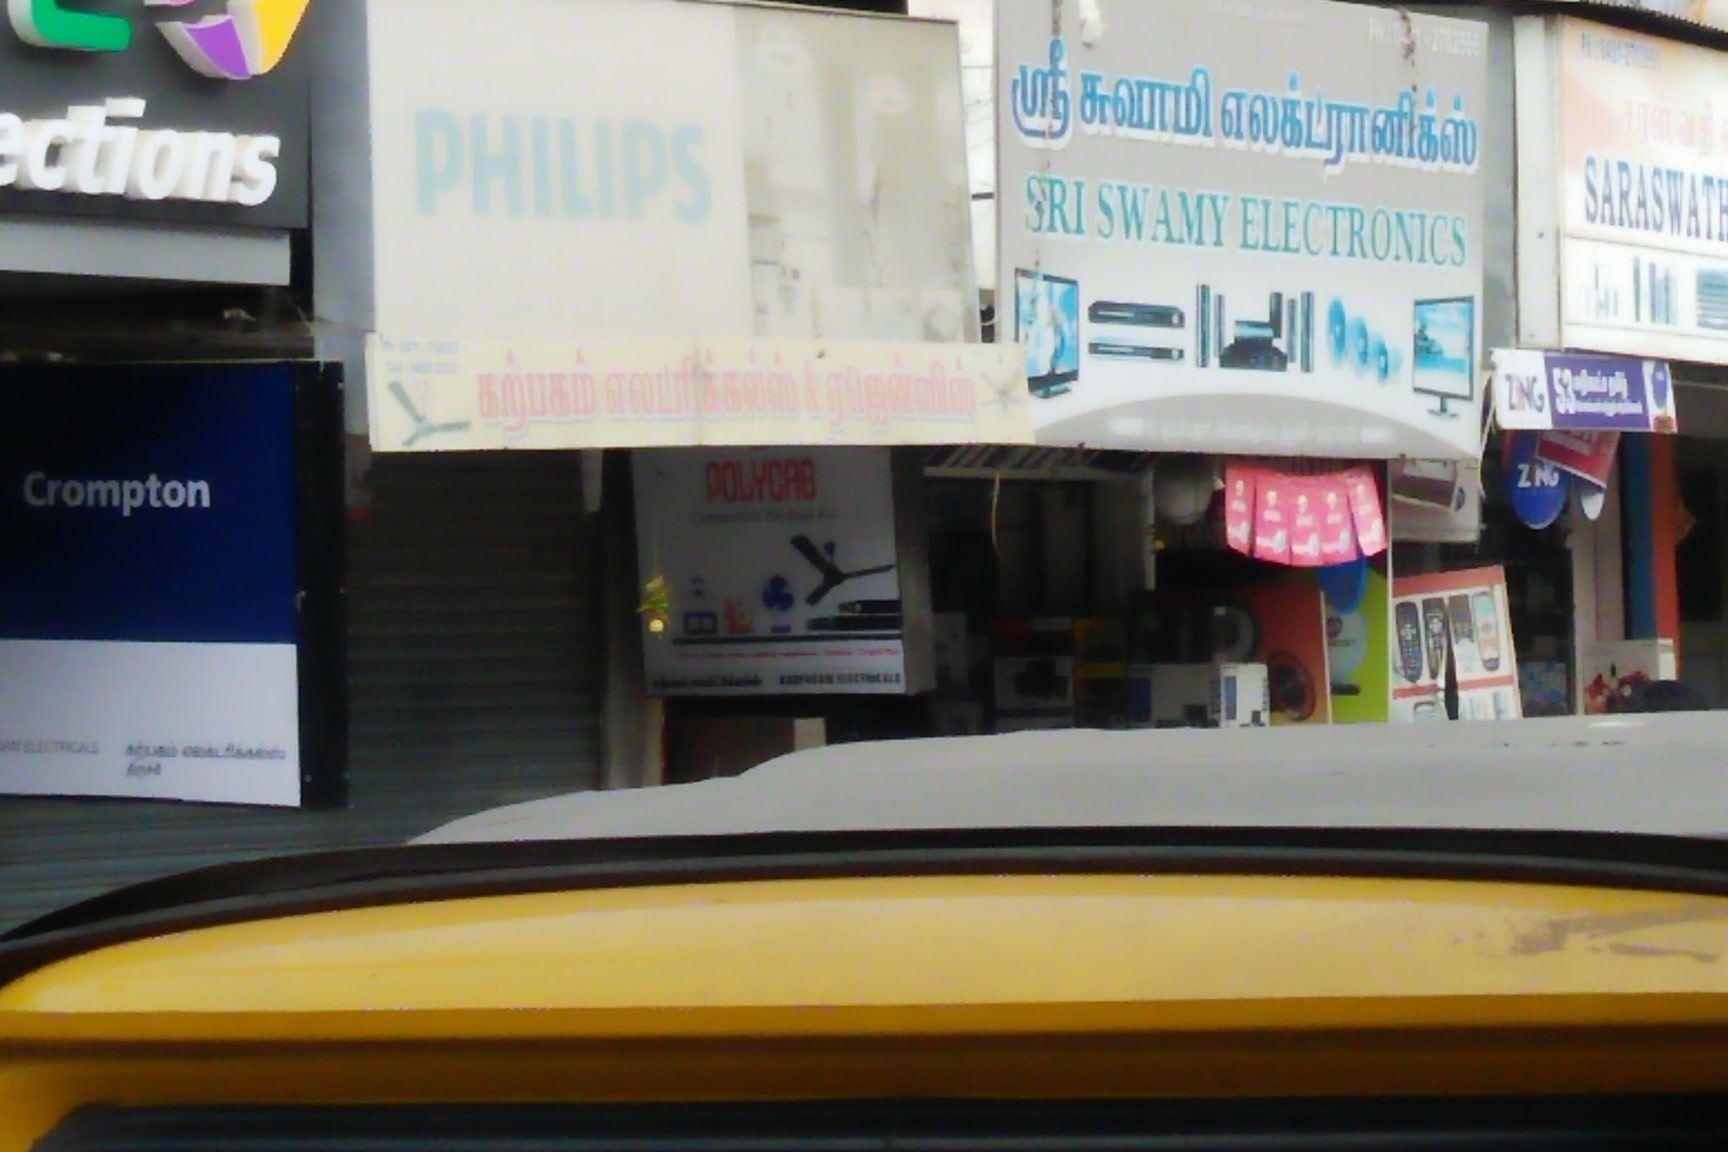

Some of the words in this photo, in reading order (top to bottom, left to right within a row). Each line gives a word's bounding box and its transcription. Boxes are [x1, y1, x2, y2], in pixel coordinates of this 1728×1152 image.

[414, 109, 713, 225] PHILIPS
[1025, 175, 1086, 235] SRI
[1097, 184, 1231, 248] SWAMY
[1240, 196, 1467, 268] ELECTRONICS
[23, 472, 211, 516] Crompton
[705, 459, 818, 503] POLYCAB
